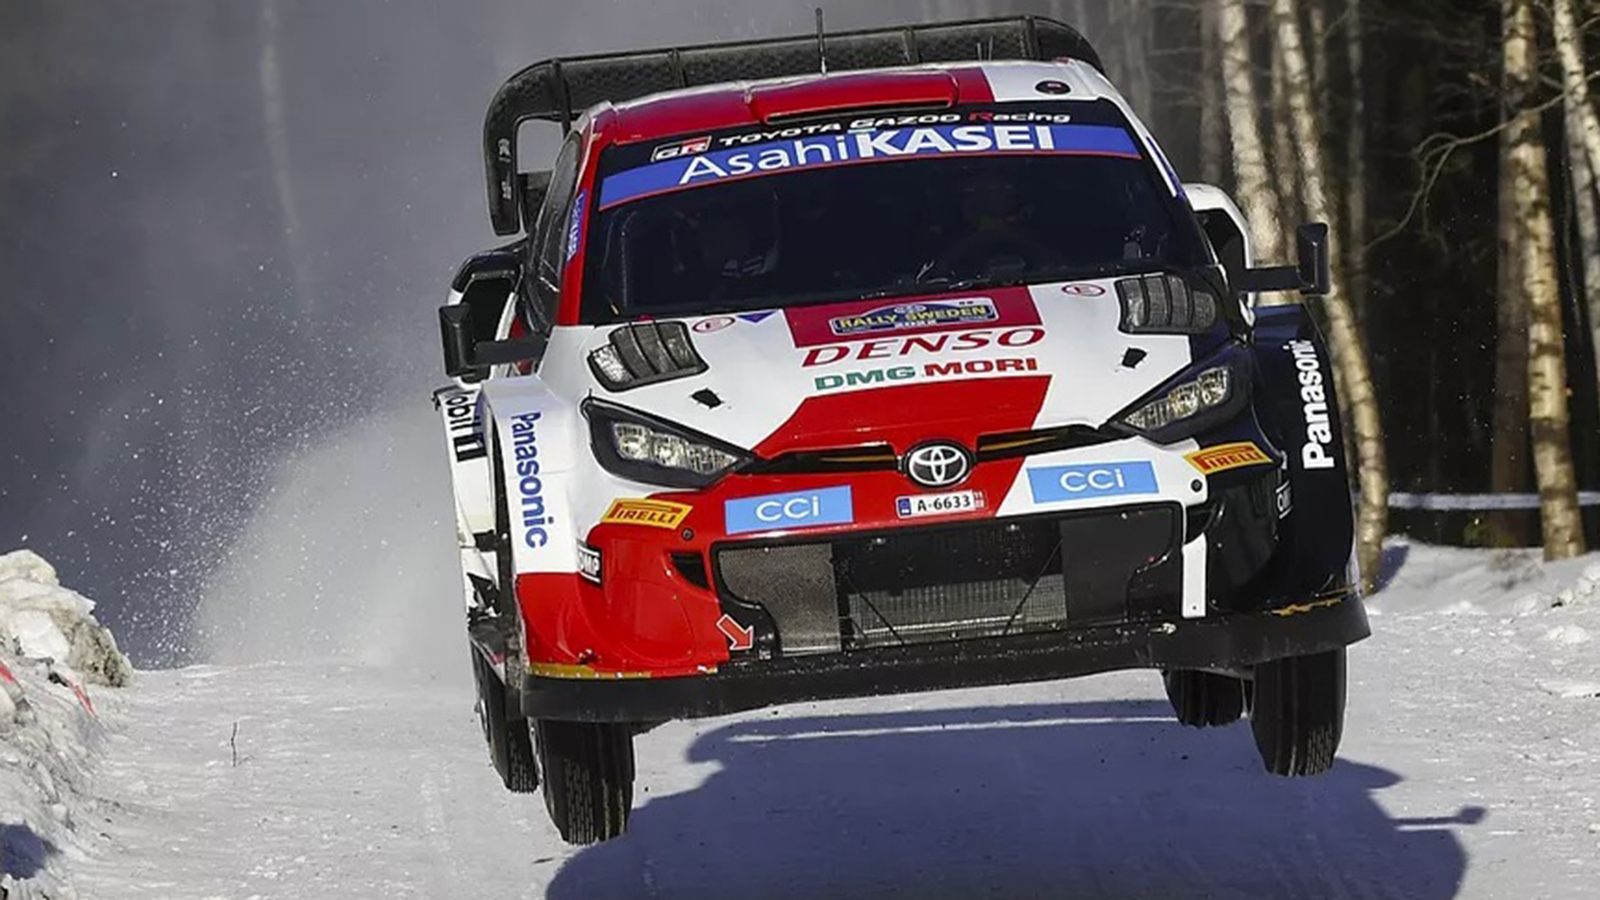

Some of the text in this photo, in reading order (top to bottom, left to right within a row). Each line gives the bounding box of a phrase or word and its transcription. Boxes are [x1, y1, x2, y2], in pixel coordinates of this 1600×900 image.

[719, 111, 1071, 147] TOYOTA GAZOO Racing
[655, 141, 707, 161] GR
[839, 314, 897, 328] RALLY
[905, 305, 986, 320] SWEDEN
[802, 328, 1047, 367] DENSO
[815, 358, 1038, 390] DMG MORI
[1192, 446, 1264, 471] PIRELLI
[511, 412, 554, 548] Panasonic
[607, 502, 683, 524] PIRELLI
[918, 495, 971, 511] A-6633
